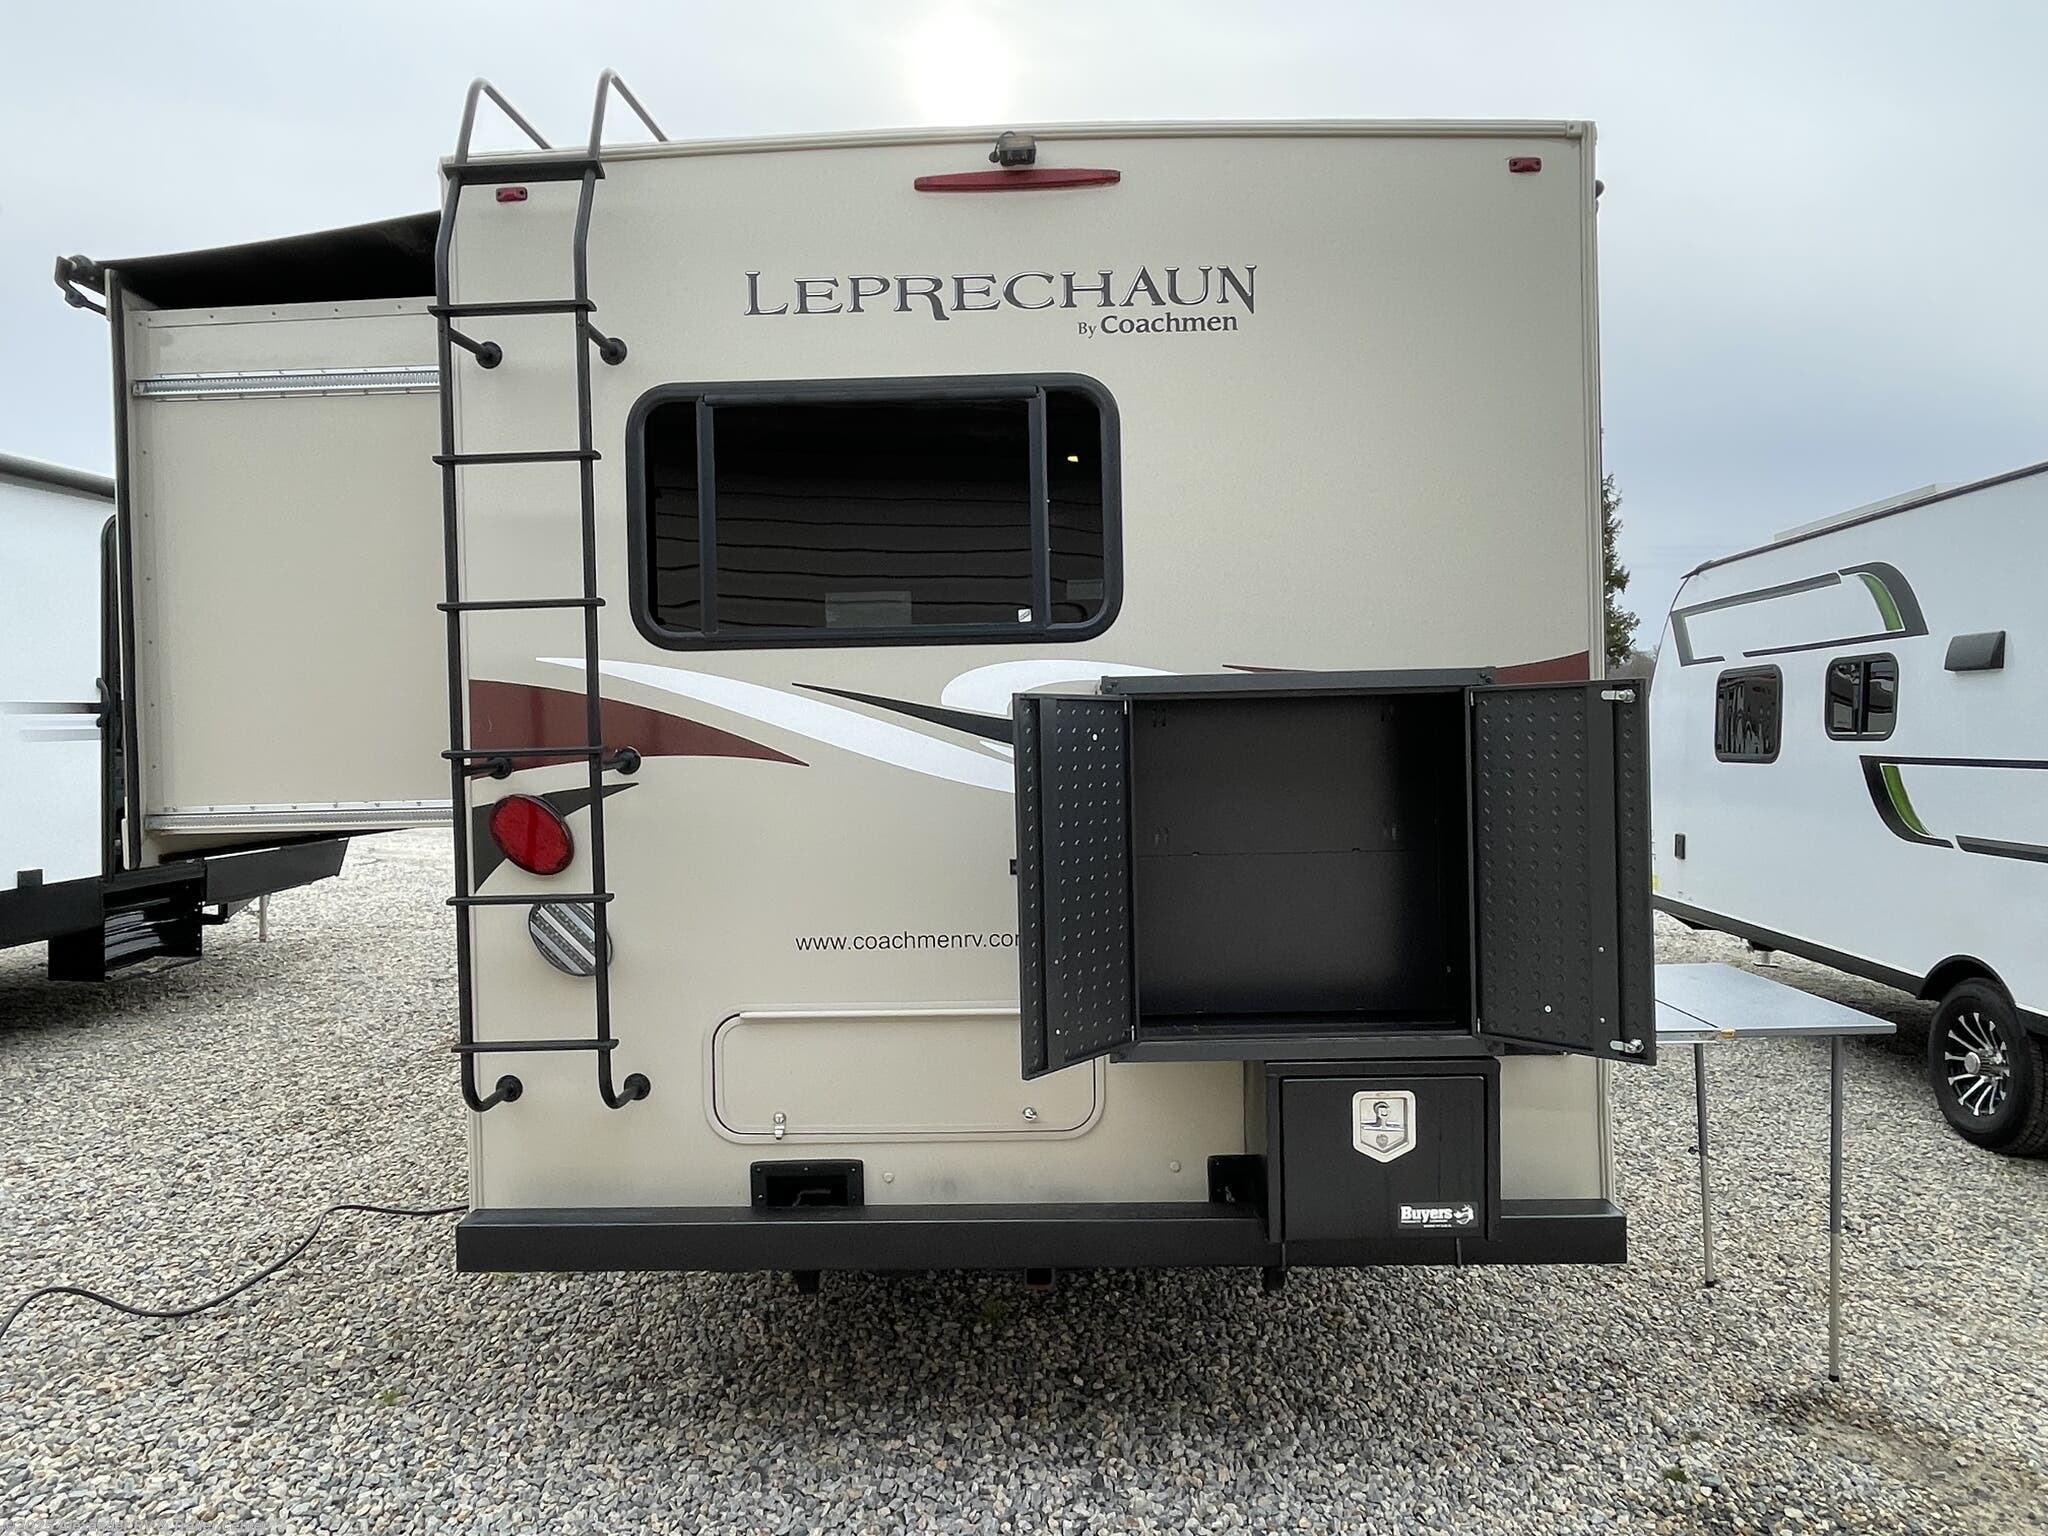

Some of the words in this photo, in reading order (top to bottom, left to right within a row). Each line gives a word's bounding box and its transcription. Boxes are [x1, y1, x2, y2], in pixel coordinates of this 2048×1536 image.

[744, 264, 1257, 321] LEPRECHAUN
[1078, 321, 1097, 339] By
[1100, 312, 1239, 334] Coachmen
[795, 931, 1019, 951] www.coachmenrv.co
[1400, 1205, 1454, 1224] Buyers
